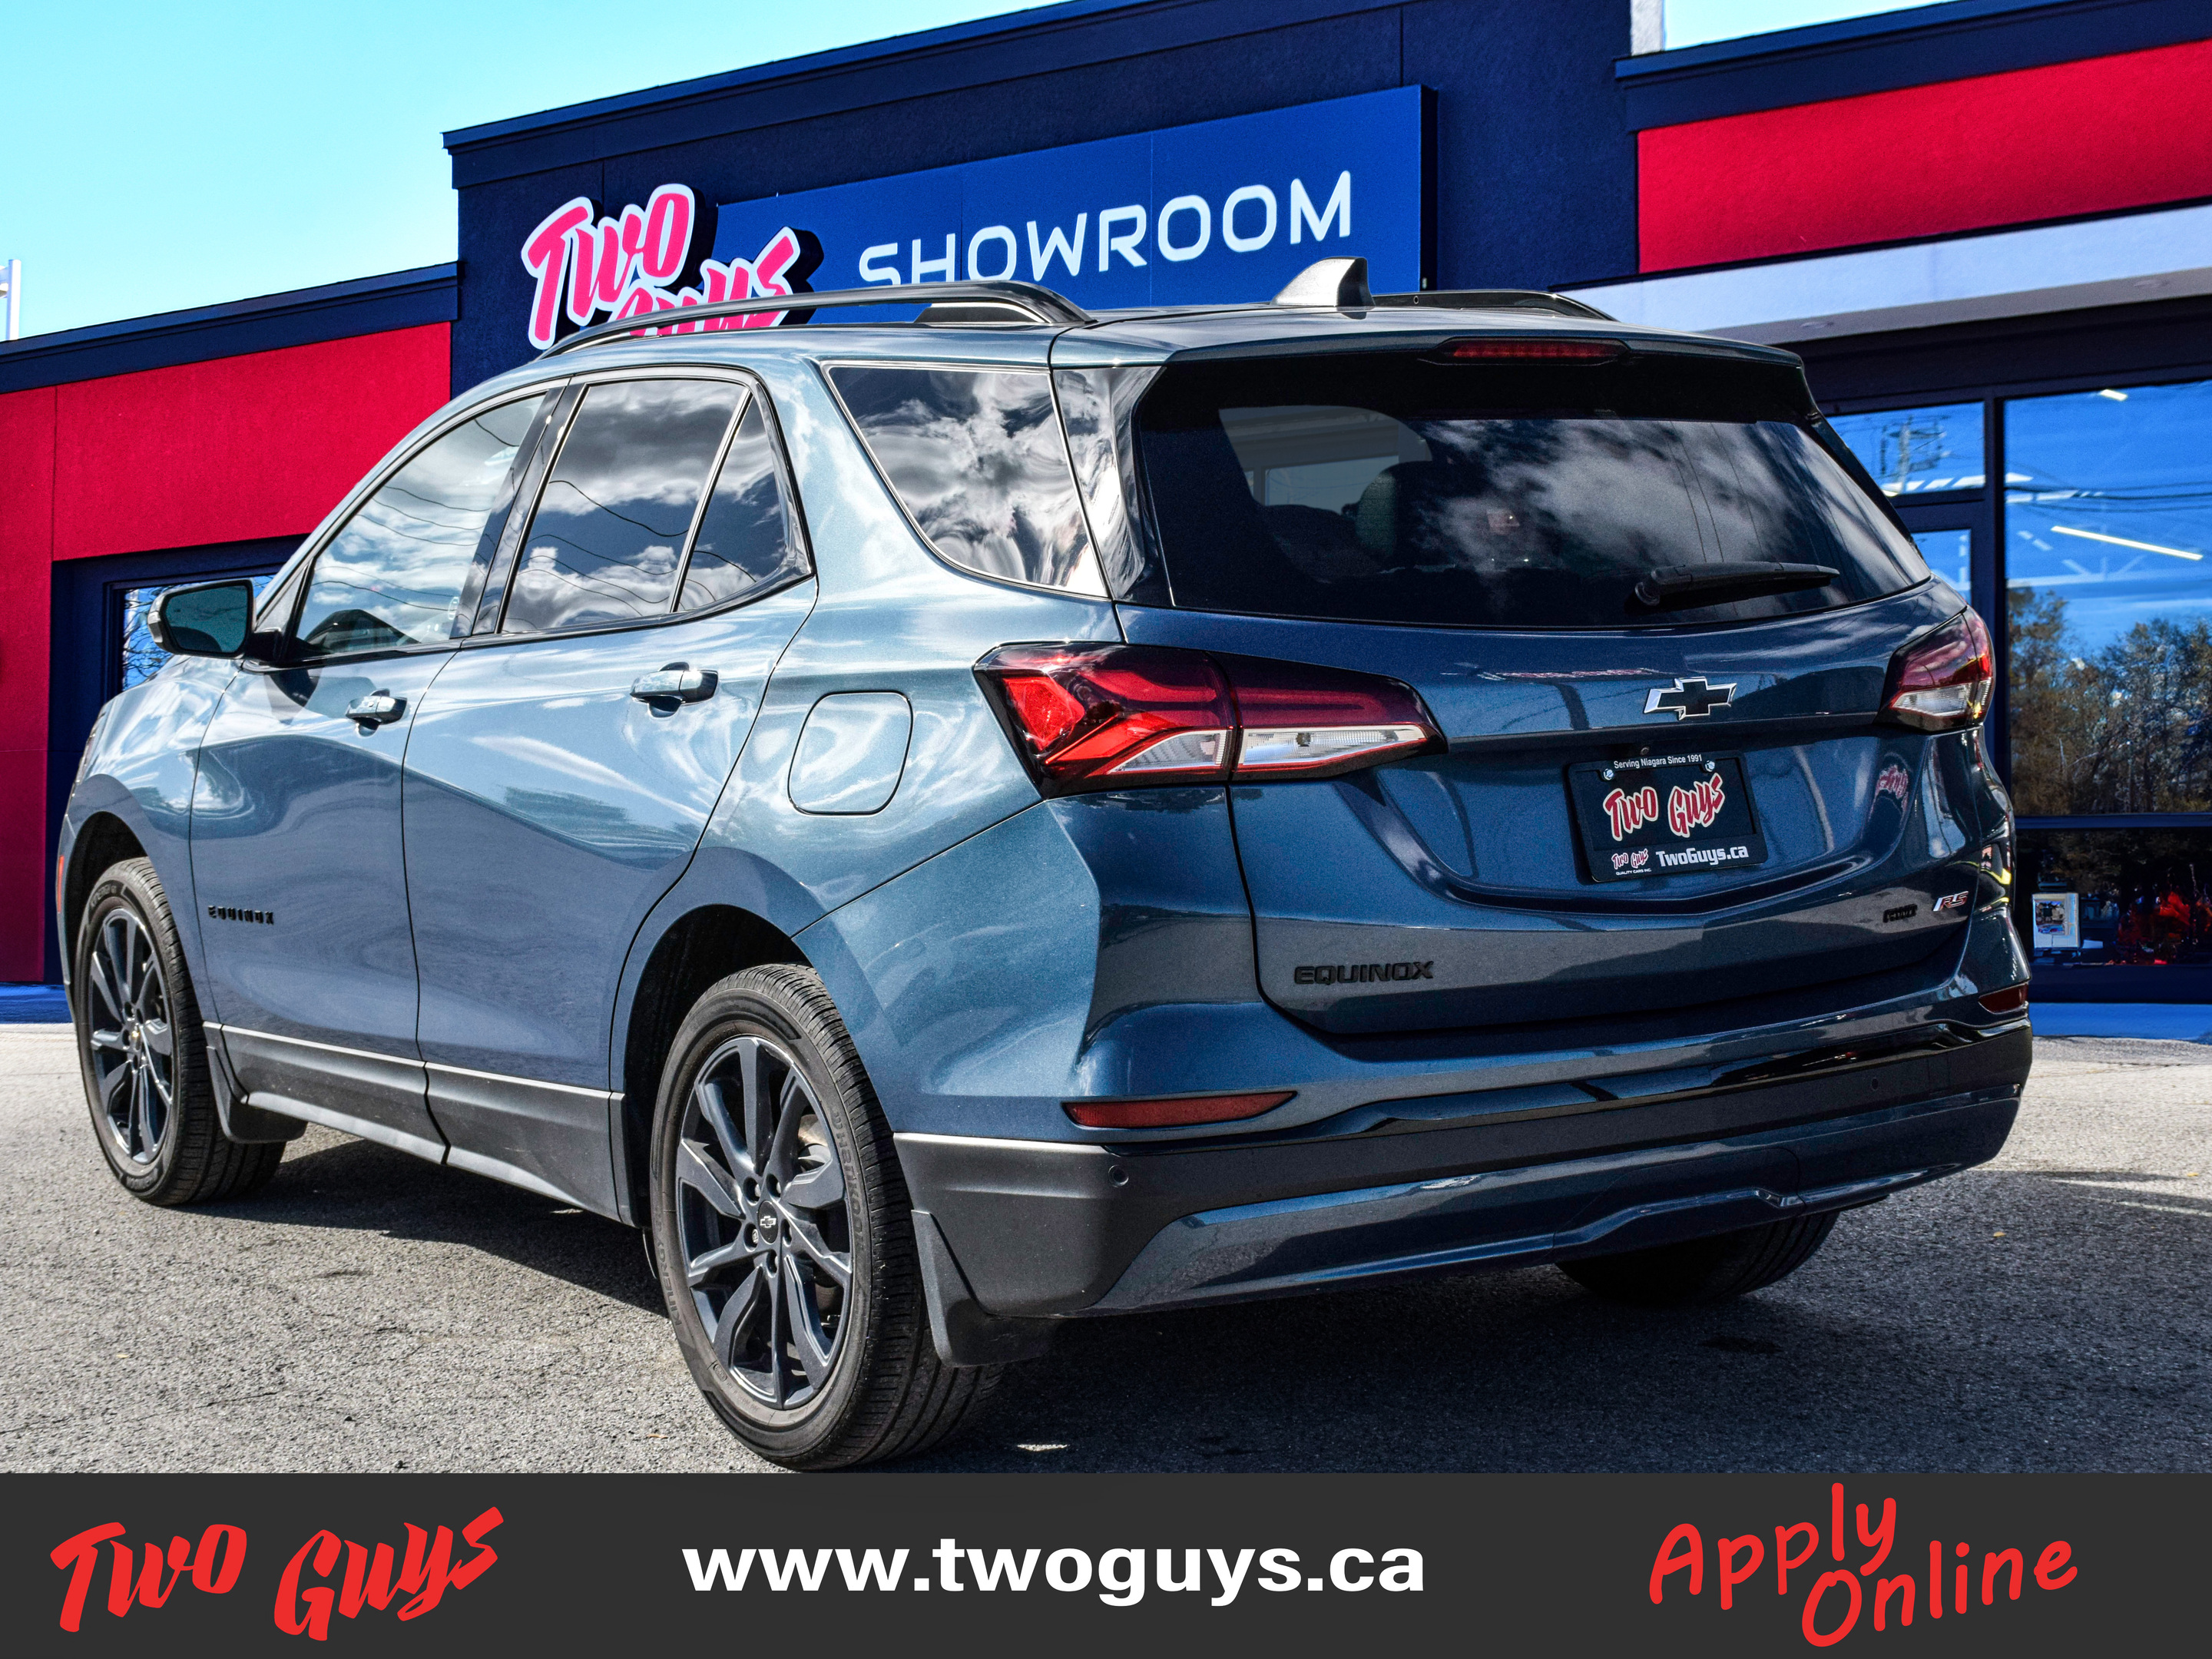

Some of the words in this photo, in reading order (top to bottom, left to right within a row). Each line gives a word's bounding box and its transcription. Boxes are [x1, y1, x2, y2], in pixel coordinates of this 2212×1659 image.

[859, 171, 1350, 285] SHOWROOM
[521, 184, 694, 349] Two
[1614, 760, 1640, 769] Serving
[1641, 758, 1667, 767] Niagara
[1603, 786, 1658, 841] Two
[1667, 773, 1725, 837] Guys
[1656, 846, 1749, 866] TwoGuys.ca
[1932, 891, 1969, 912] RS
[207, 906, 274, 925] EQUINOX
[1294, 961, 1434, 985] EQUINOX
